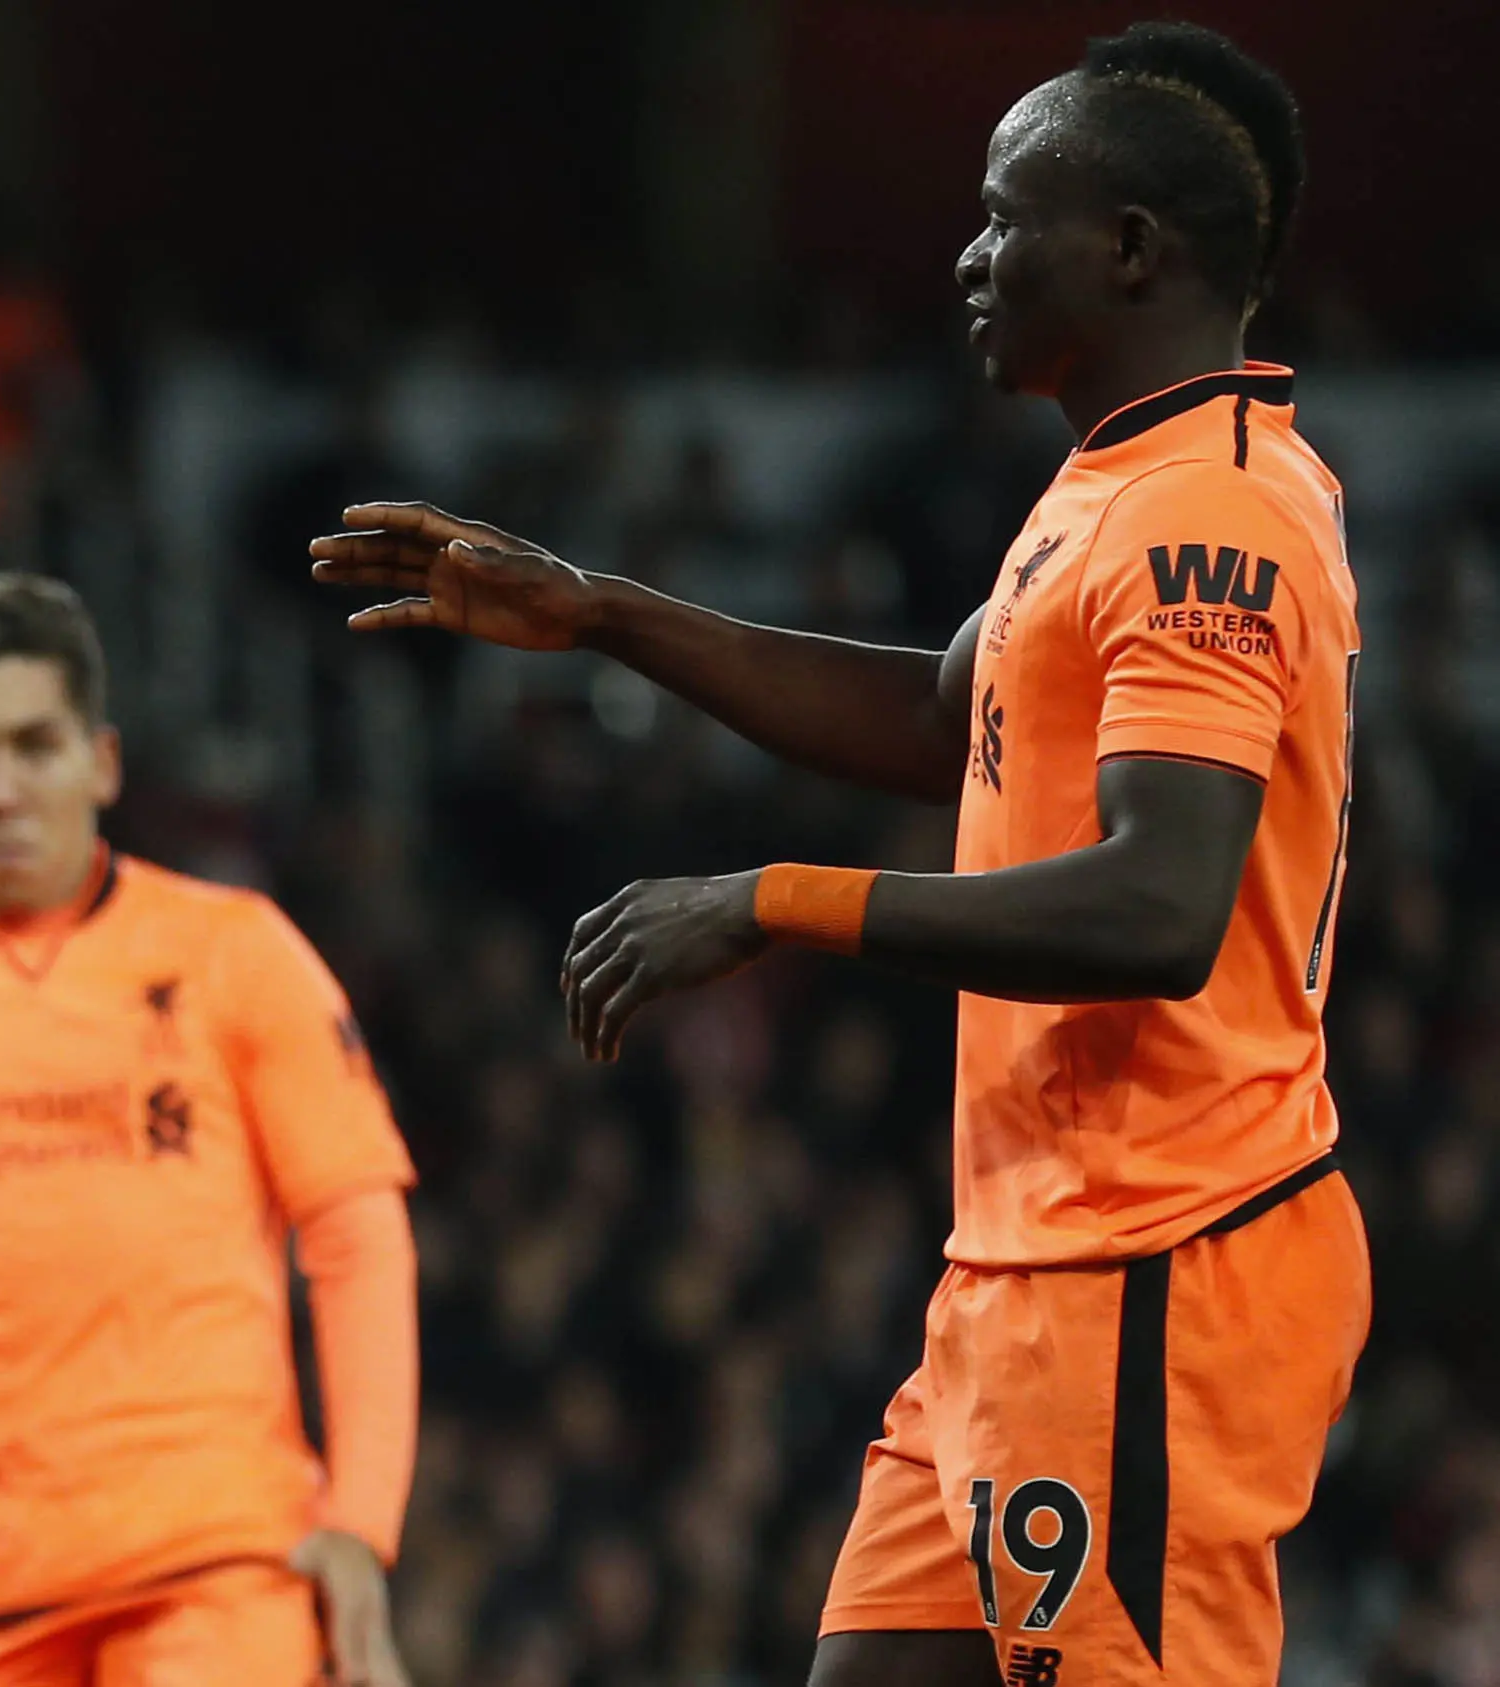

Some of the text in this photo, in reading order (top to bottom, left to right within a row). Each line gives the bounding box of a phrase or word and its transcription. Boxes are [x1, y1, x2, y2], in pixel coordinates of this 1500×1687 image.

[1147, 544, 1280, 611] WU
[1148, 611, 1276, 635] WESTERN
[1189, 631, 1271, 655] UNION
[965, 1477, 1092, 1631] 19
